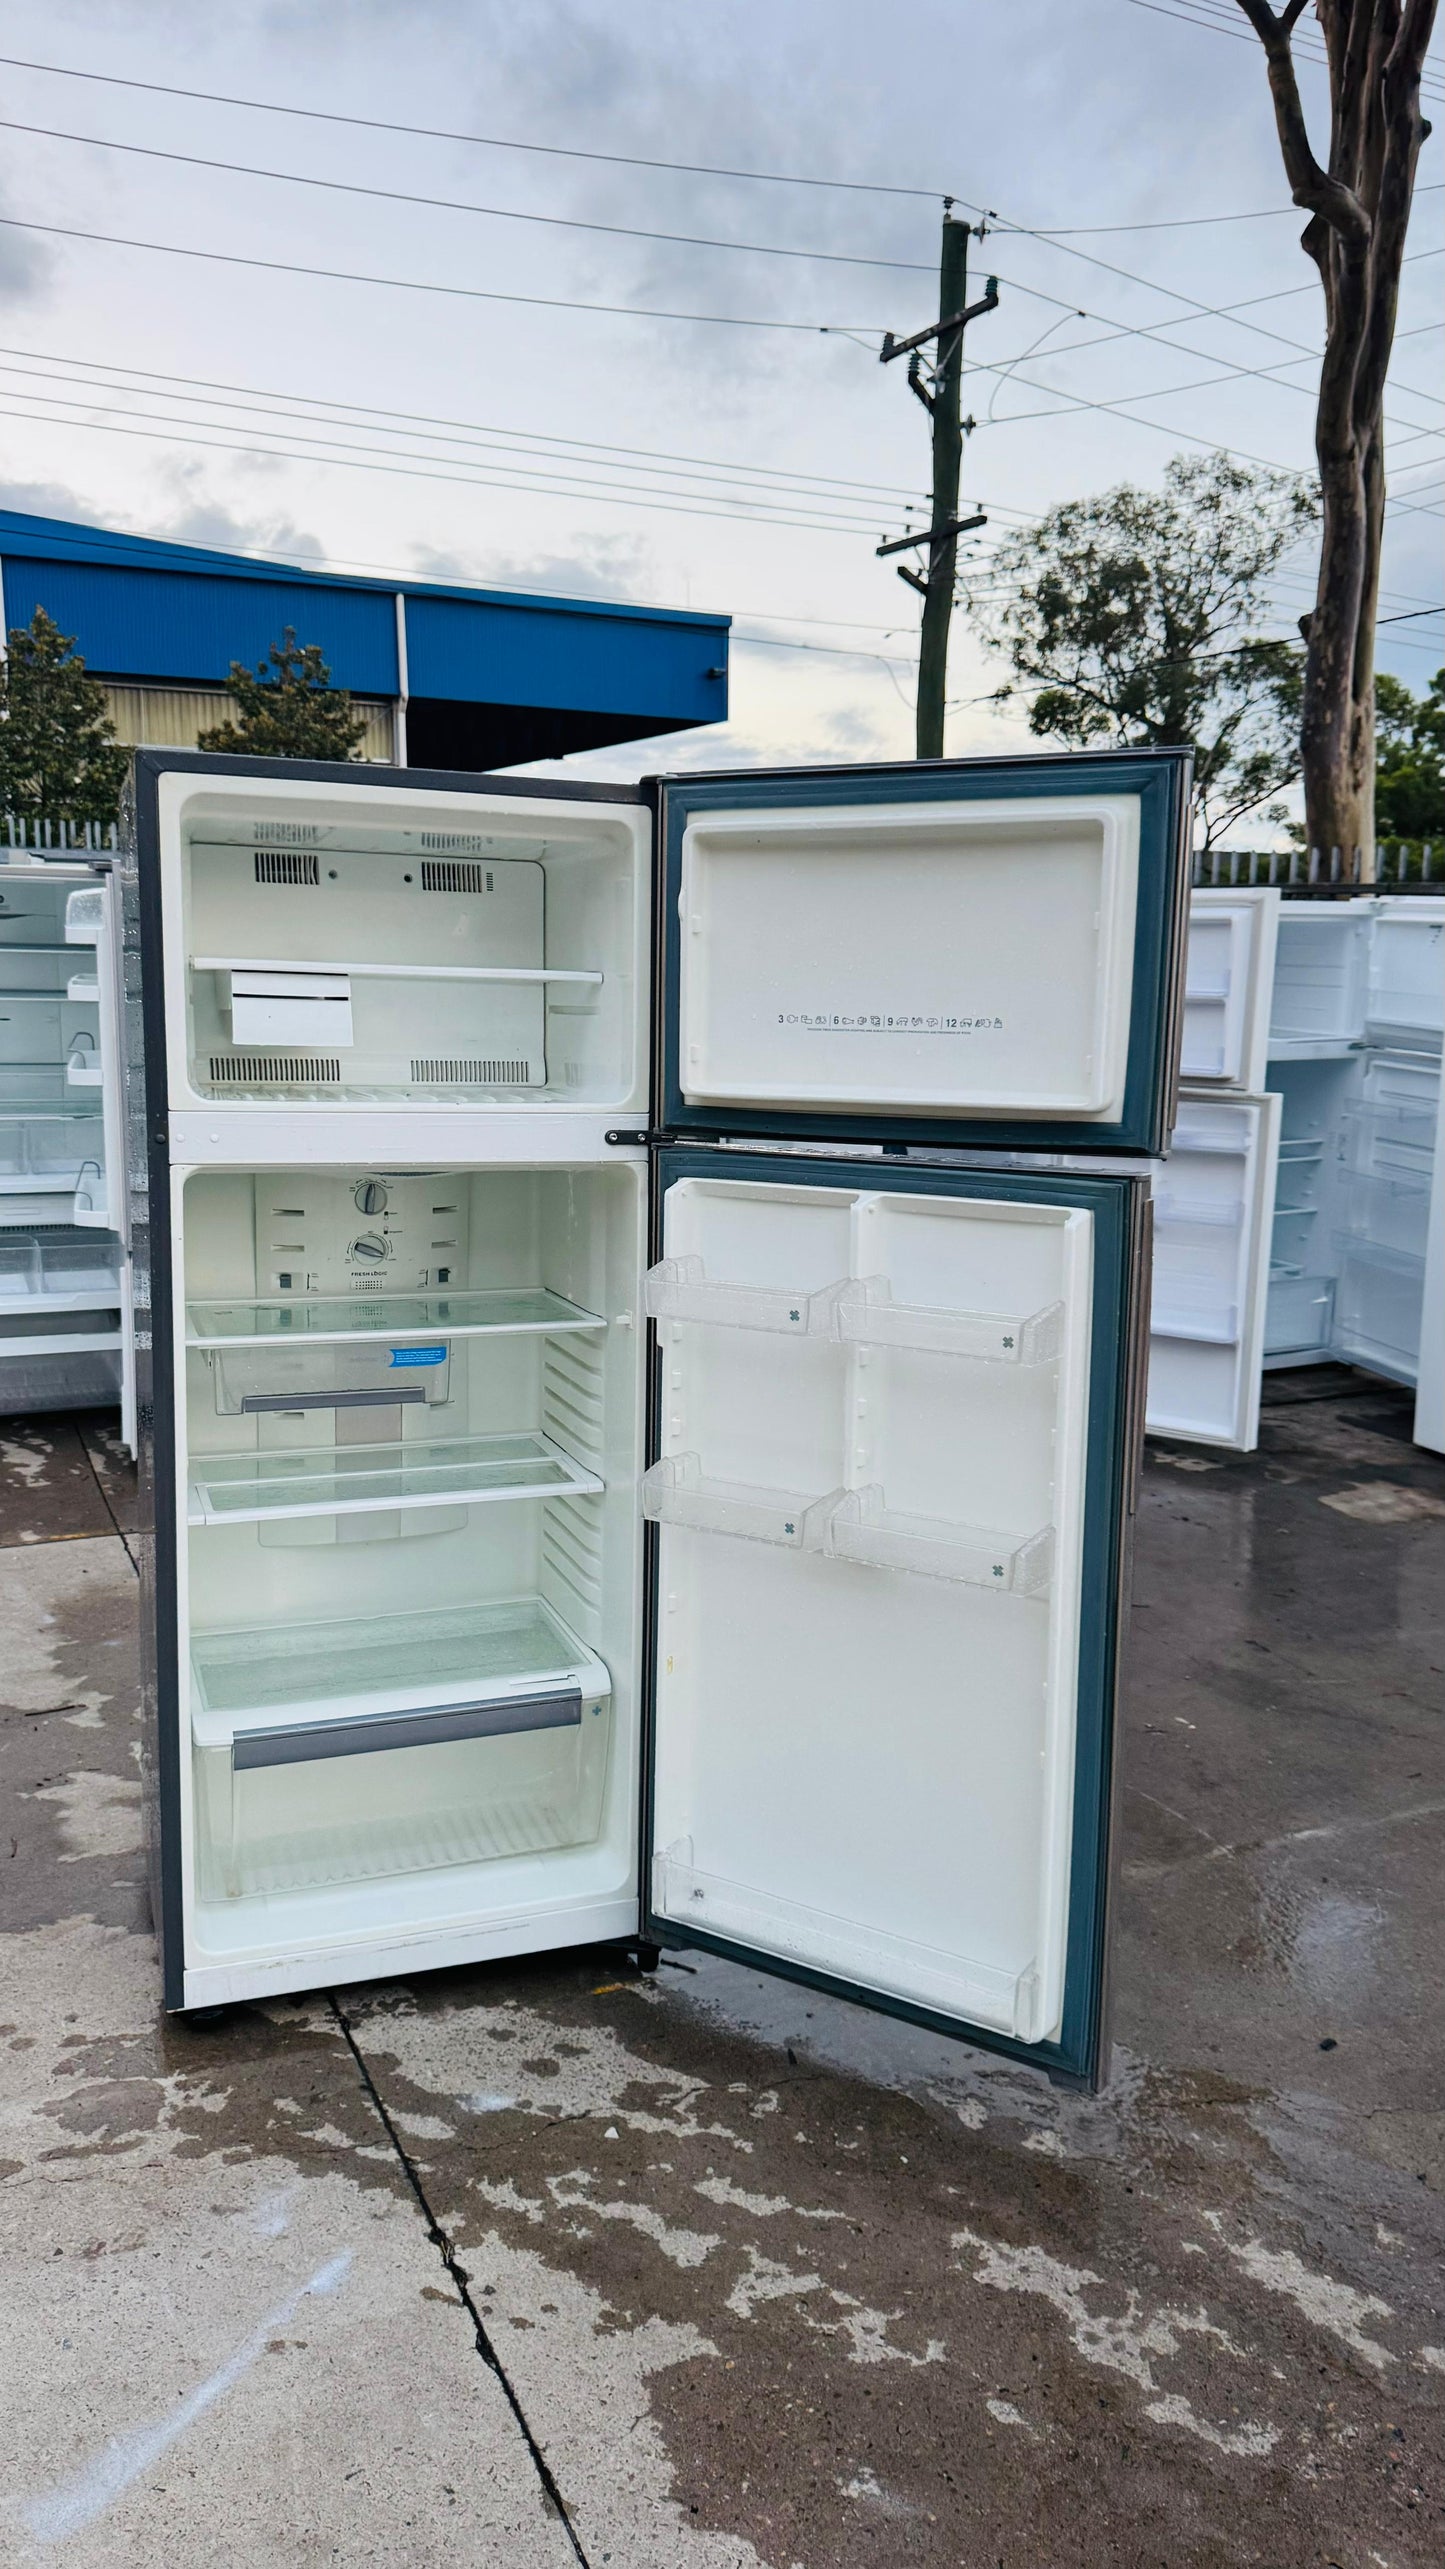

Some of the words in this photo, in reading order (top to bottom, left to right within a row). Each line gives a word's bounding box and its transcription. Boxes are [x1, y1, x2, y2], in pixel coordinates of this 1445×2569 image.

[778, 1014, 784, 1024] 3
[833, 1015, 840, 1025] 6
[887, 1017, 894, 1026] 9
[946, 1018, 958, 1028] 12
